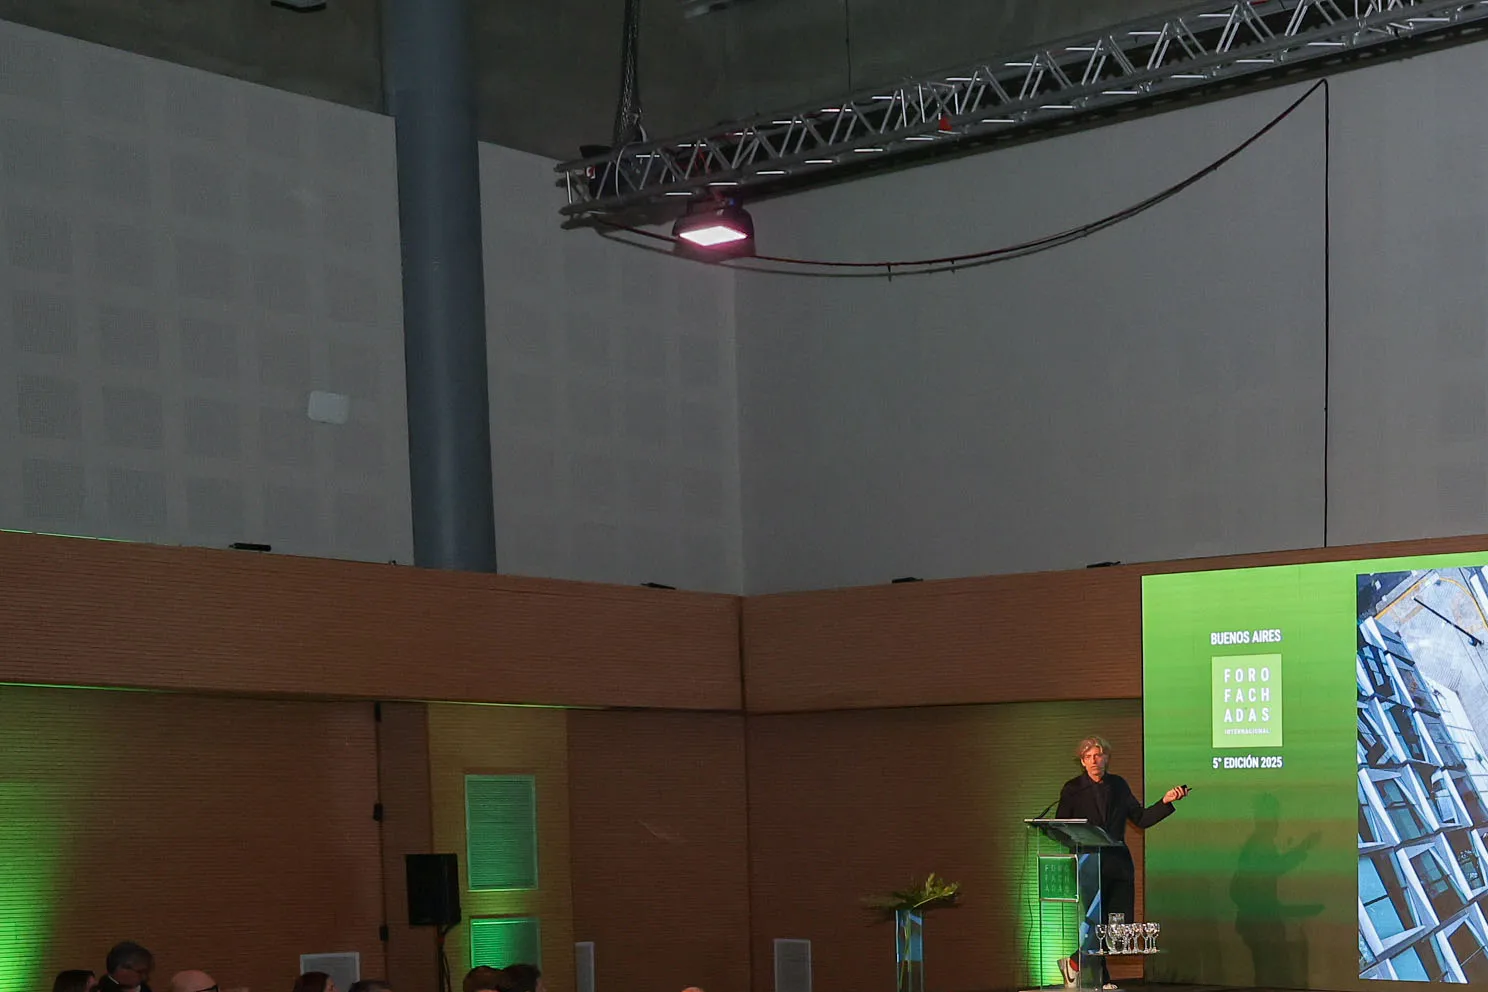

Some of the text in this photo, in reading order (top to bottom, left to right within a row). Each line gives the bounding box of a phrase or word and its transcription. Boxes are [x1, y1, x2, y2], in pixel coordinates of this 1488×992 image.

[1210, 629, 1281, 645] BUENOS AIRES
[1224, 667, 1270, 683] FORO
[1224, 688, 1270, 702] FACH
[1224, 708, 1270, 722] ADAS
[1224, 754, 1259, 768] EDICIÓN
[1261, 756, 1283, 768] 2025
